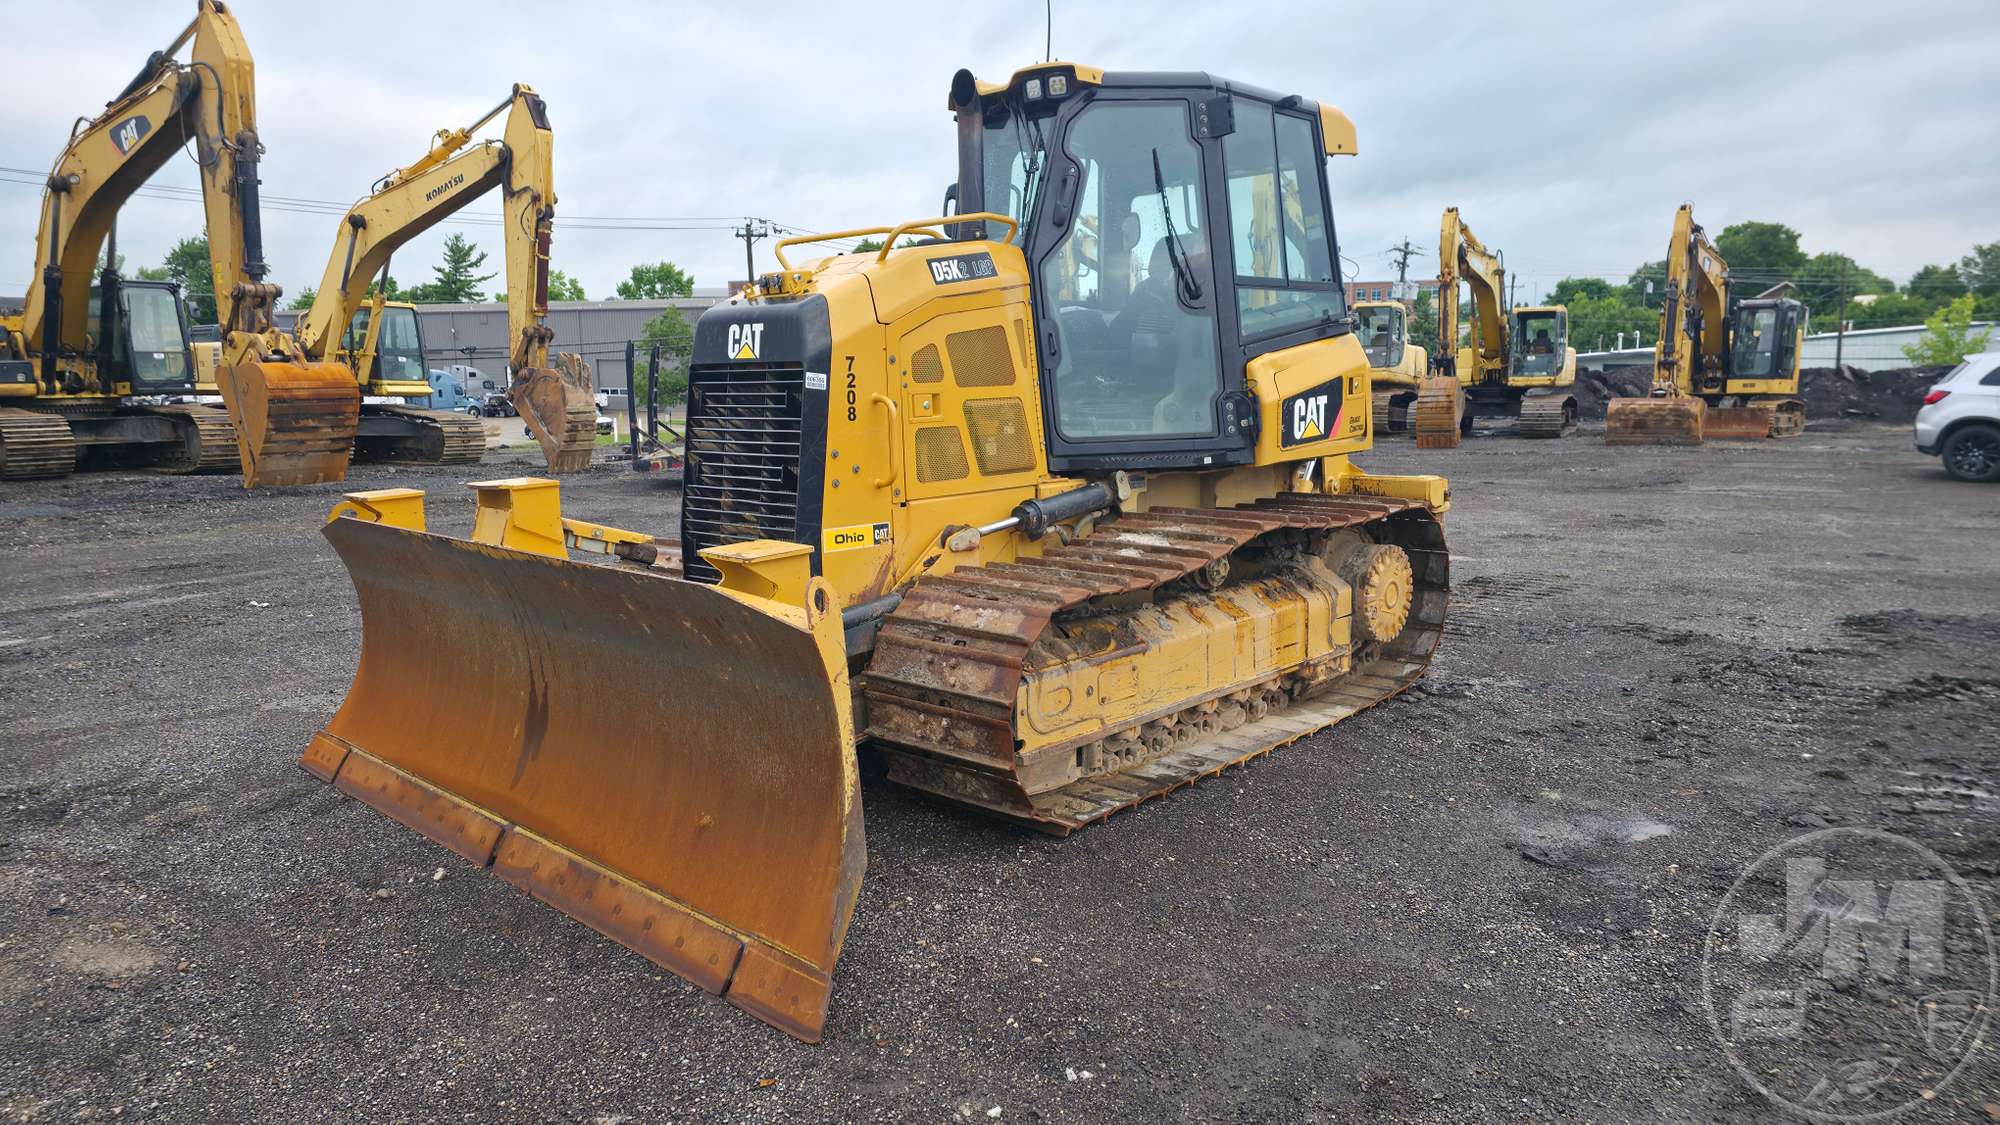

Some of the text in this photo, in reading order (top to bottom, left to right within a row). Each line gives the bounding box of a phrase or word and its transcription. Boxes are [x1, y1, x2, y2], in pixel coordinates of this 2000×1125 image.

[120, 118, 139, 151] CAT
[425, 172, 464, 202] KOMATSU
[728, 323, 764, 360] CAT
[845, 355, 857, 422] 7208
[1293, 395, 1328, 440] CAT
[834, 528, 888, 544] Ohio CAT
